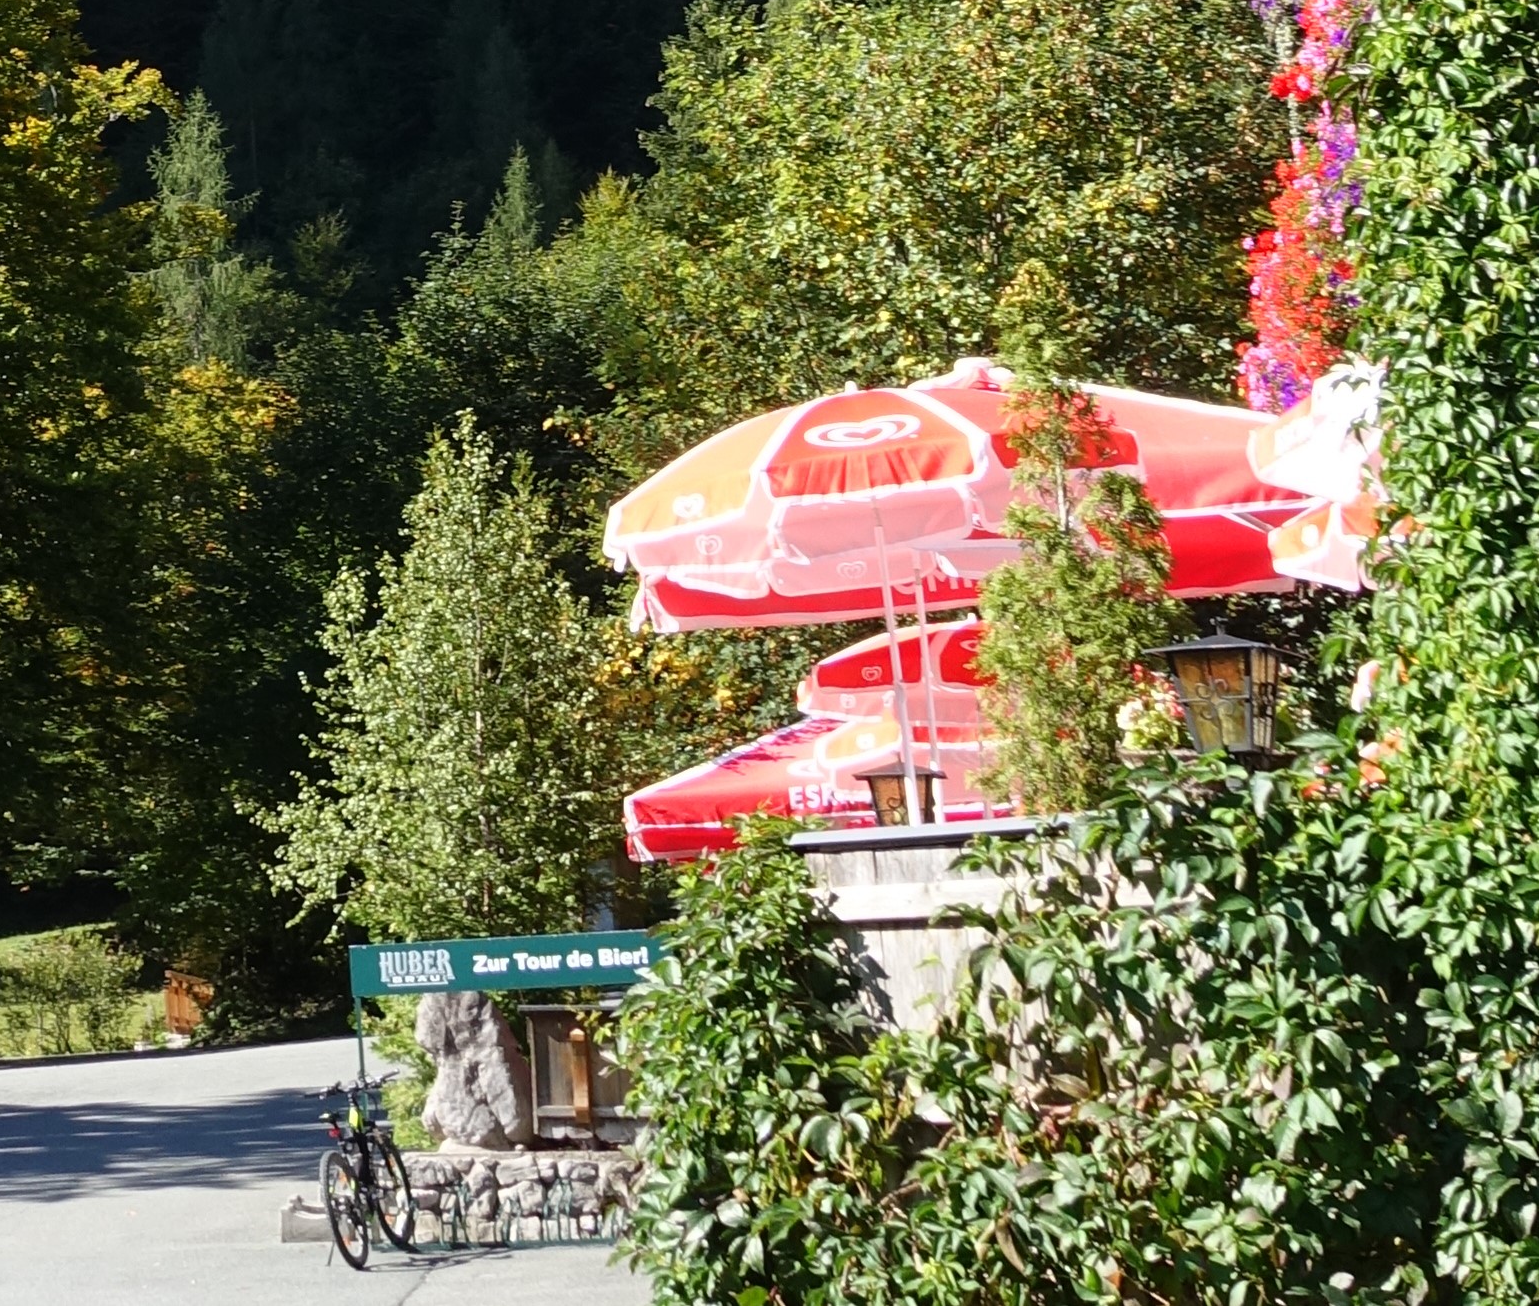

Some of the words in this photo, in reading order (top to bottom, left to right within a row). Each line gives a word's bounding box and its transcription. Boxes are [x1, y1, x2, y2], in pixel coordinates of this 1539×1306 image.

[788, 783, 844, 810] ESK
[379, 949, 455, 982] HUBER
[472, 955, 510, 973] Zur
[513, 952, 562, 971] Tour
[566, 950, 593, 968] de
[597, 946, 649, 967] Bier!
